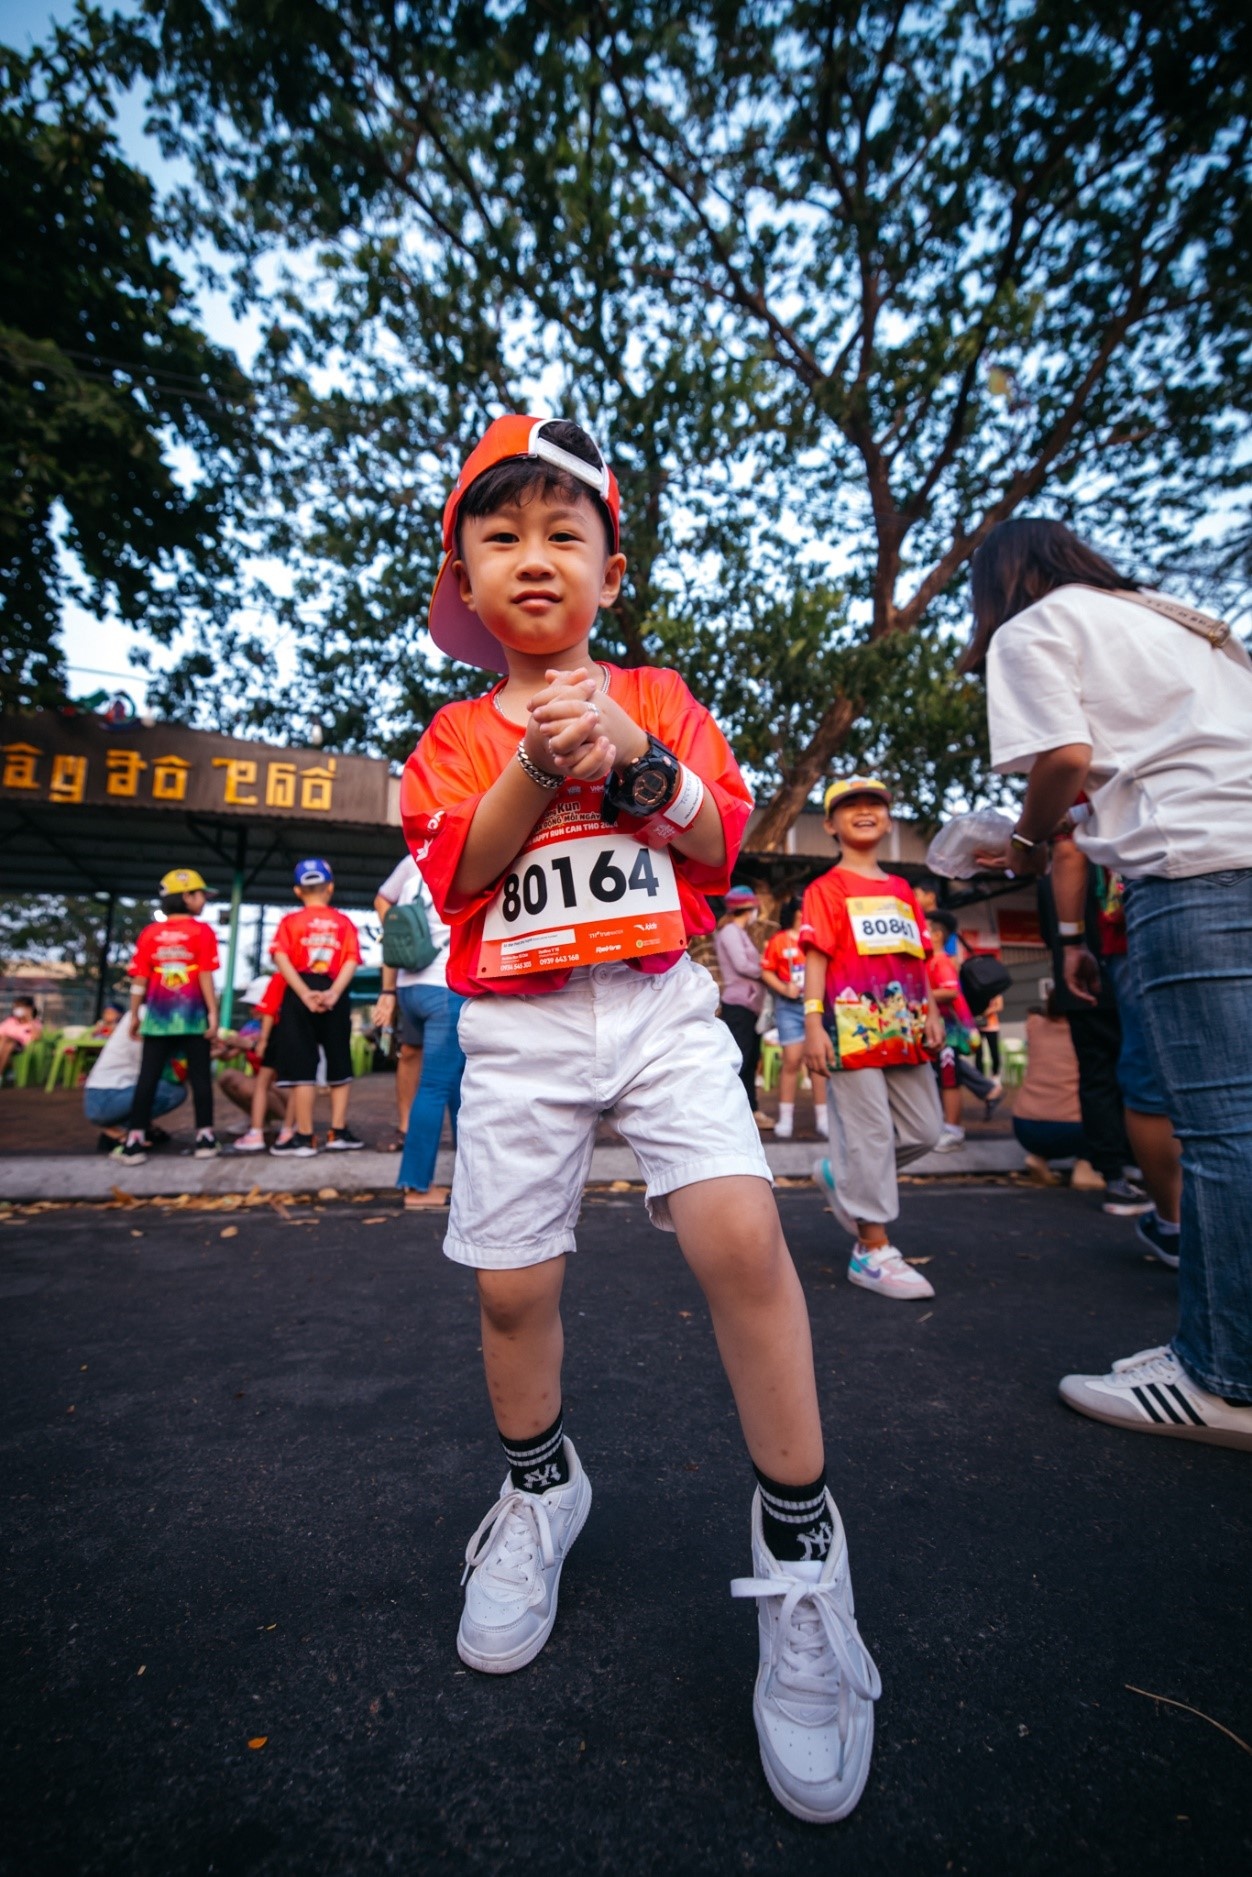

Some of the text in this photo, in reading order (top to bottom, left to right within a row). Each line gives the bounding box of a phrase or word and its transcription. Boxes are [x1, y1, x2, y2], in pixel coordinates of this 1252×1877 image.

[557, 802, 580, 813] Kun
[550, 828, 565, 837] RUN
[565, 824, 582, 834] CAN
[583, 822, 599, 831] THO
[502, 848, 660, 922] 80164
